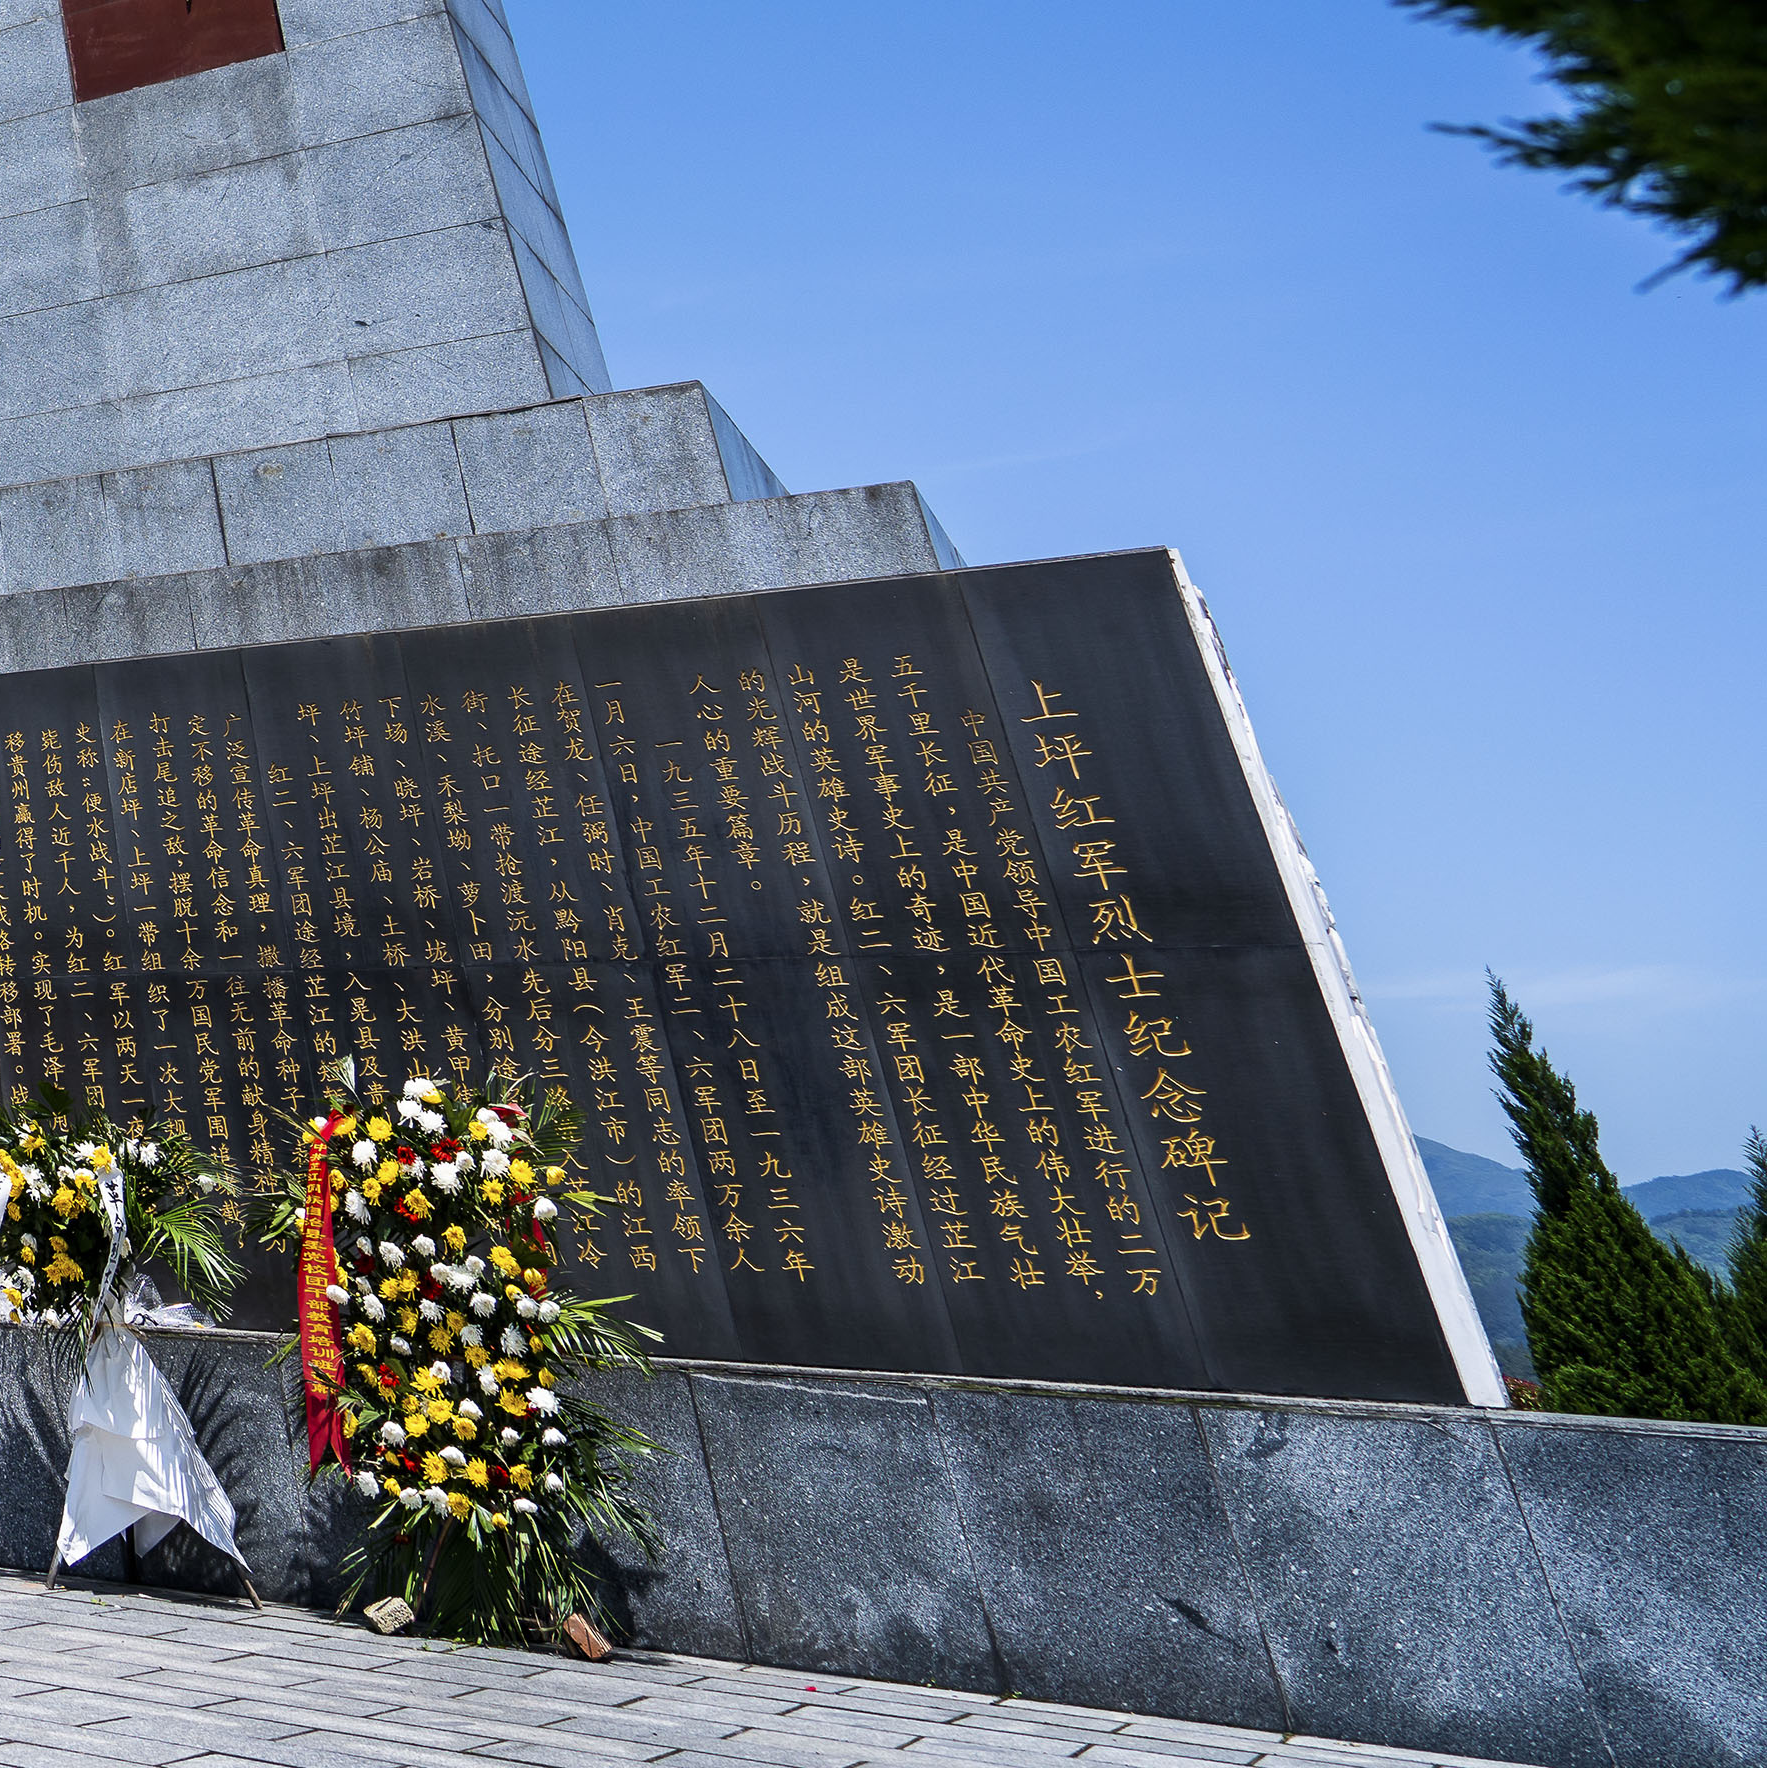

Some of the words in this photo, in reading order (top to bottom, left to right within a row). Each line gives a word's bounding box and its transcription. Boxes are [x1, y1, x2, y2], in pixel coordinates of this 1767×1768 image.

[546, 678, 713, 1274] 在贺龙、任弼时、肖克、王震等同志的率领下
[593, 679, 765, 1272] 一月六日，中国工农红军二、六军团两万余人
[654, 740, 819, 1282] 一九三五年十二月二十八日至一九三六年
[683, 671, 774, 891] 人心的重要篇章。
[731, 667, 932, 1285] 的光辉战斗历程，就是组成这部英雄史诗激动
[784, 662, 988, 1282] 山河的英雄史诗。红二、六军团长征经过芷江
[832, 657, 1050, 1290] 是世界军事史上的奇迹，是一部中华民族气壮
[885, 654, 1117, 1299] 五千里长征，是中国近代革命史上的伟大壮举，
[953, 708, 1177, 1296] 中国共产党领导中国工农红军进行的二万
[1006, 677, 1255, 1241] 上坪红军烈士纪念碑记
